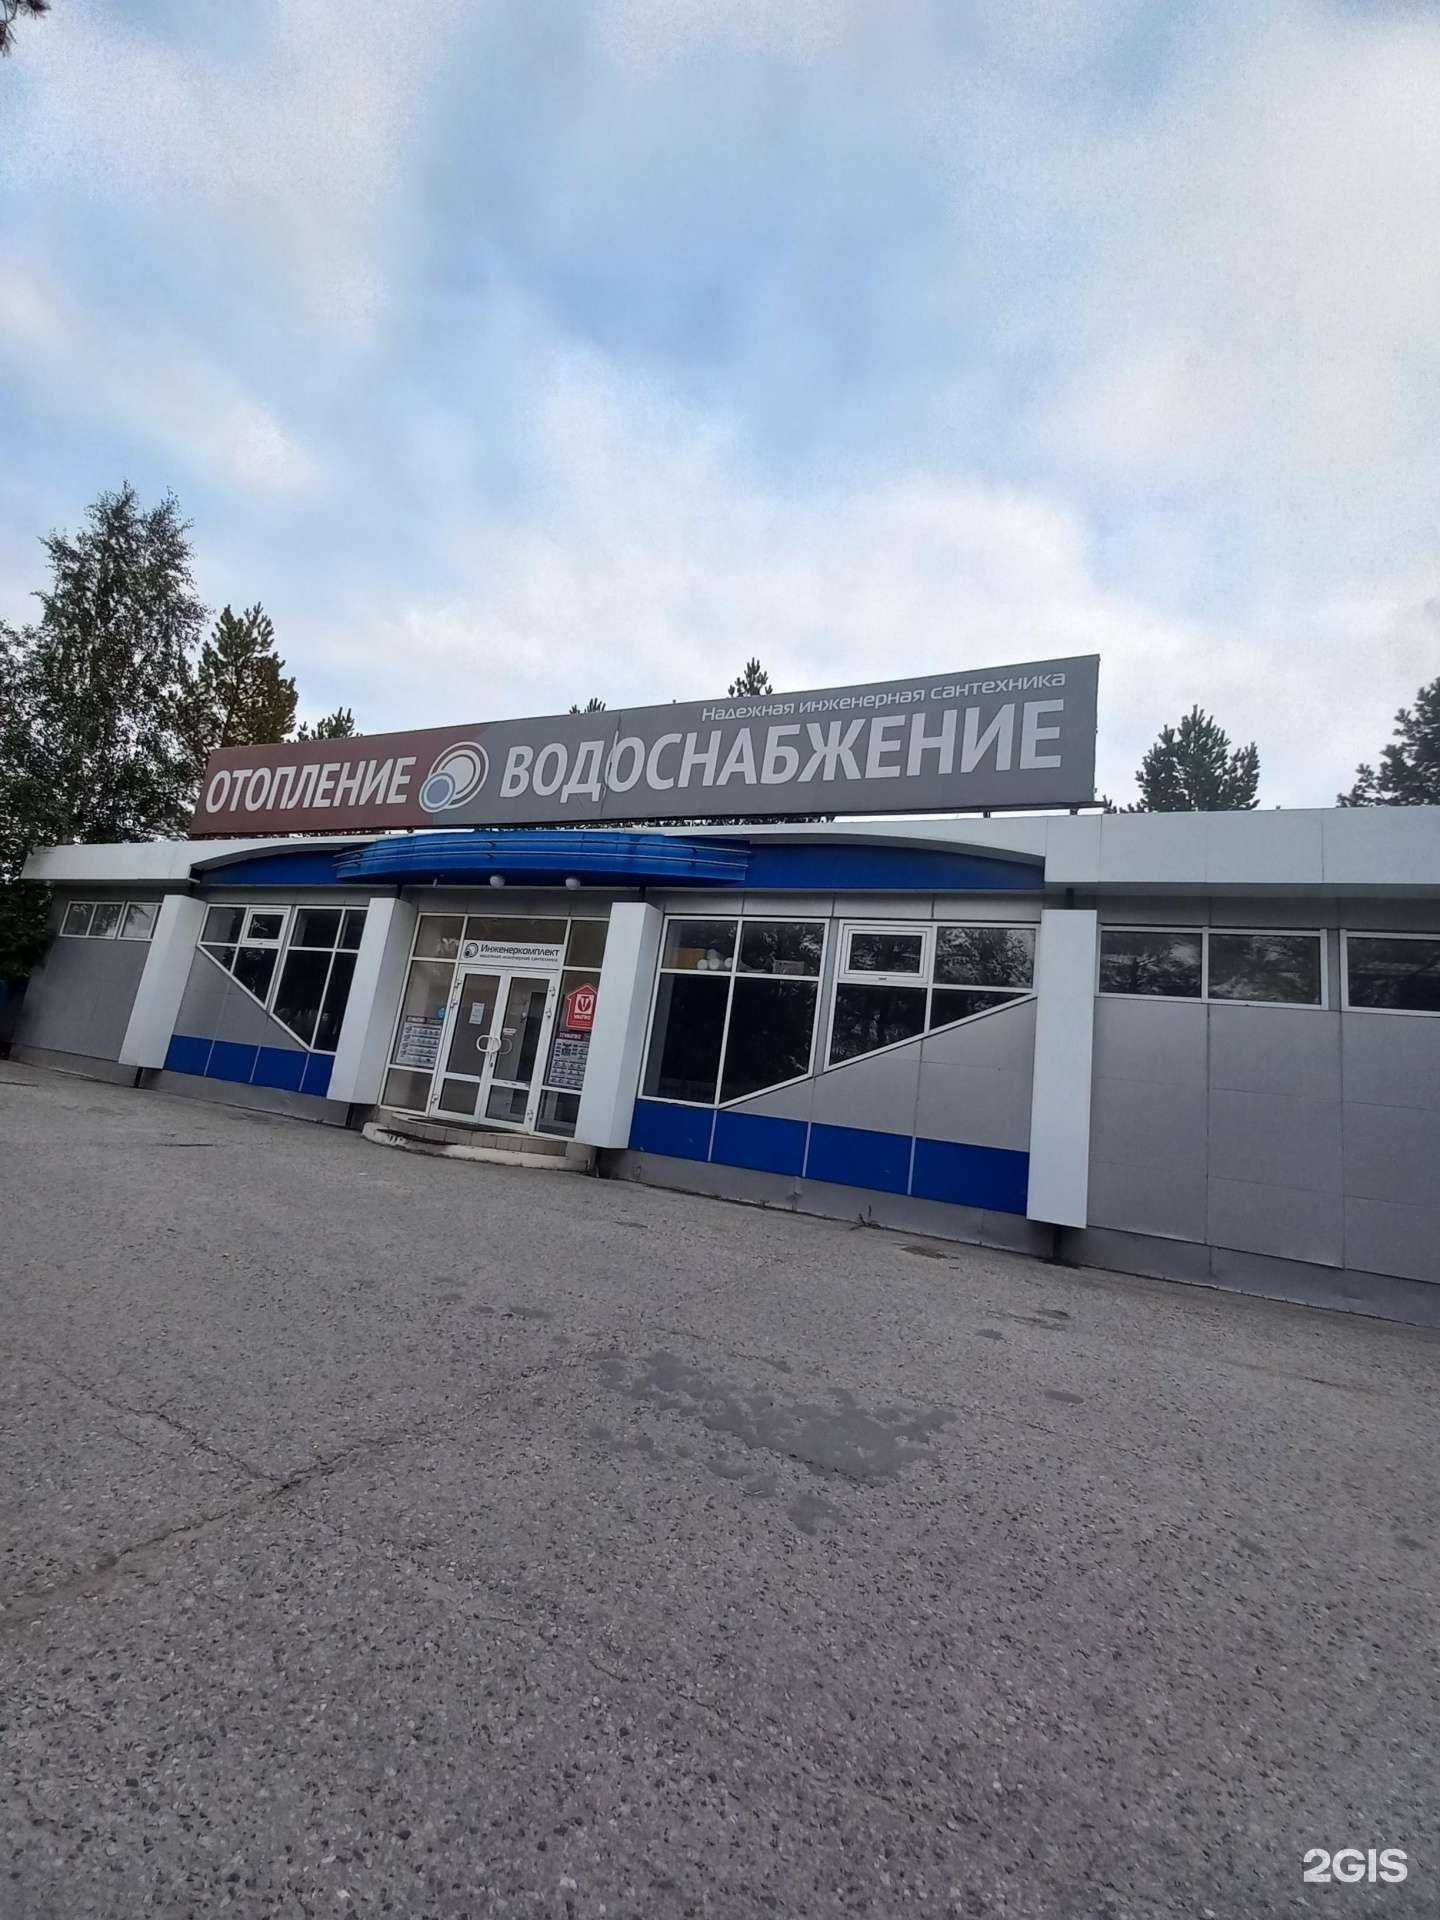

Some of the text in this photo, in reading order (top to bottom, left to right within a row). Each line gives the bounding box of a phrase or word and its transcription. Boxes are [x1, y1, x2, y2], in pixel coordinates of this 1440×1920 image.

[702, 672, 1066, 722] Надежная инженерная сантехника
[499, 698, 1064, 803] ВОДОСНАБЖЕНИЕ
[206, 755, 417, 813] ОТОПЛЕНИЕ
[480, 943, 560, 957] Инженеркомплект
